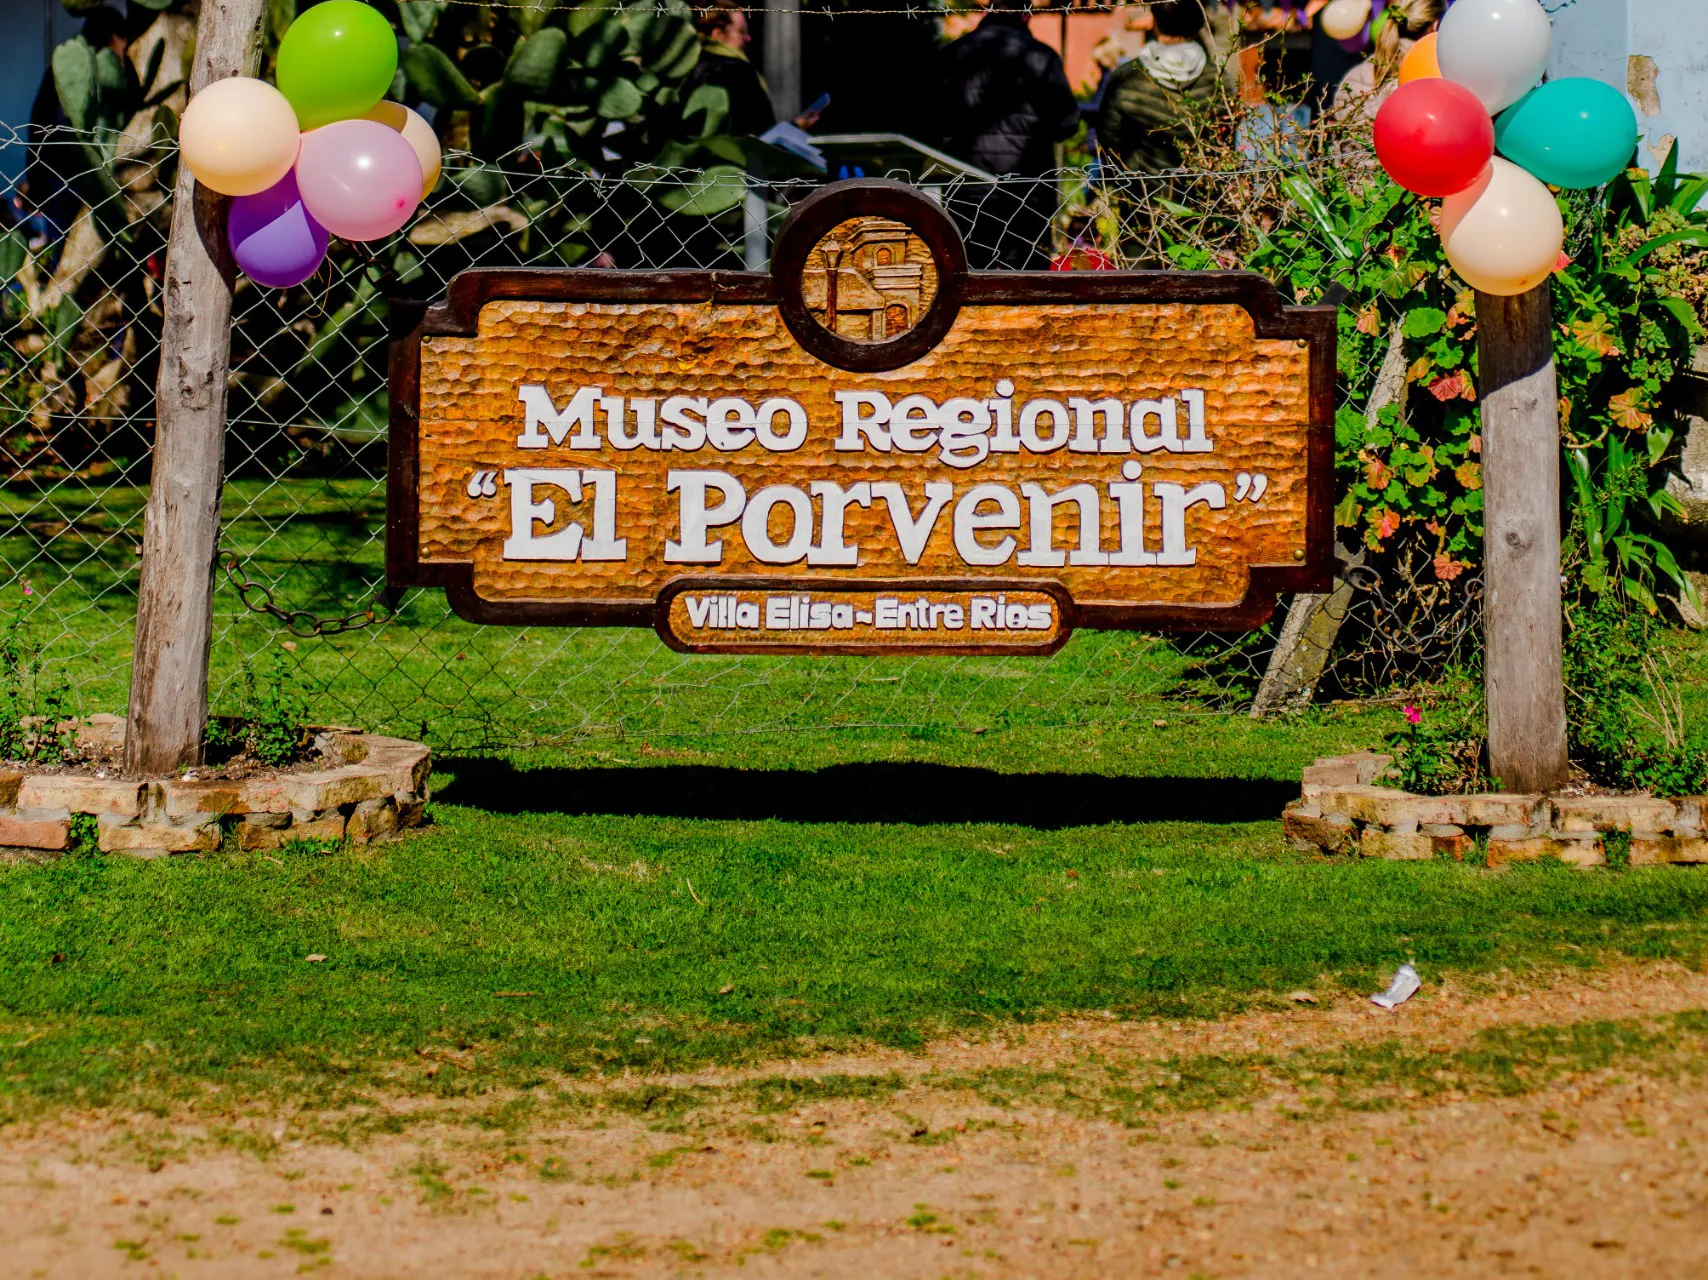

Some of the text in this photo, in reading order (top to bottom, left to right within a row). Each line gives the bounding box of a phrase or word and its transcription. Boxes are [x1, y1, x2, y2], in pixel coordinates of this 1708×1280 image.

[516, 379, 1214, 468] Museo Regional
[467, 459, 1268, 567] “El Porvenir”
[684, 594, 760, 629] Villa
[970, 593, 1053, 630] Rios
